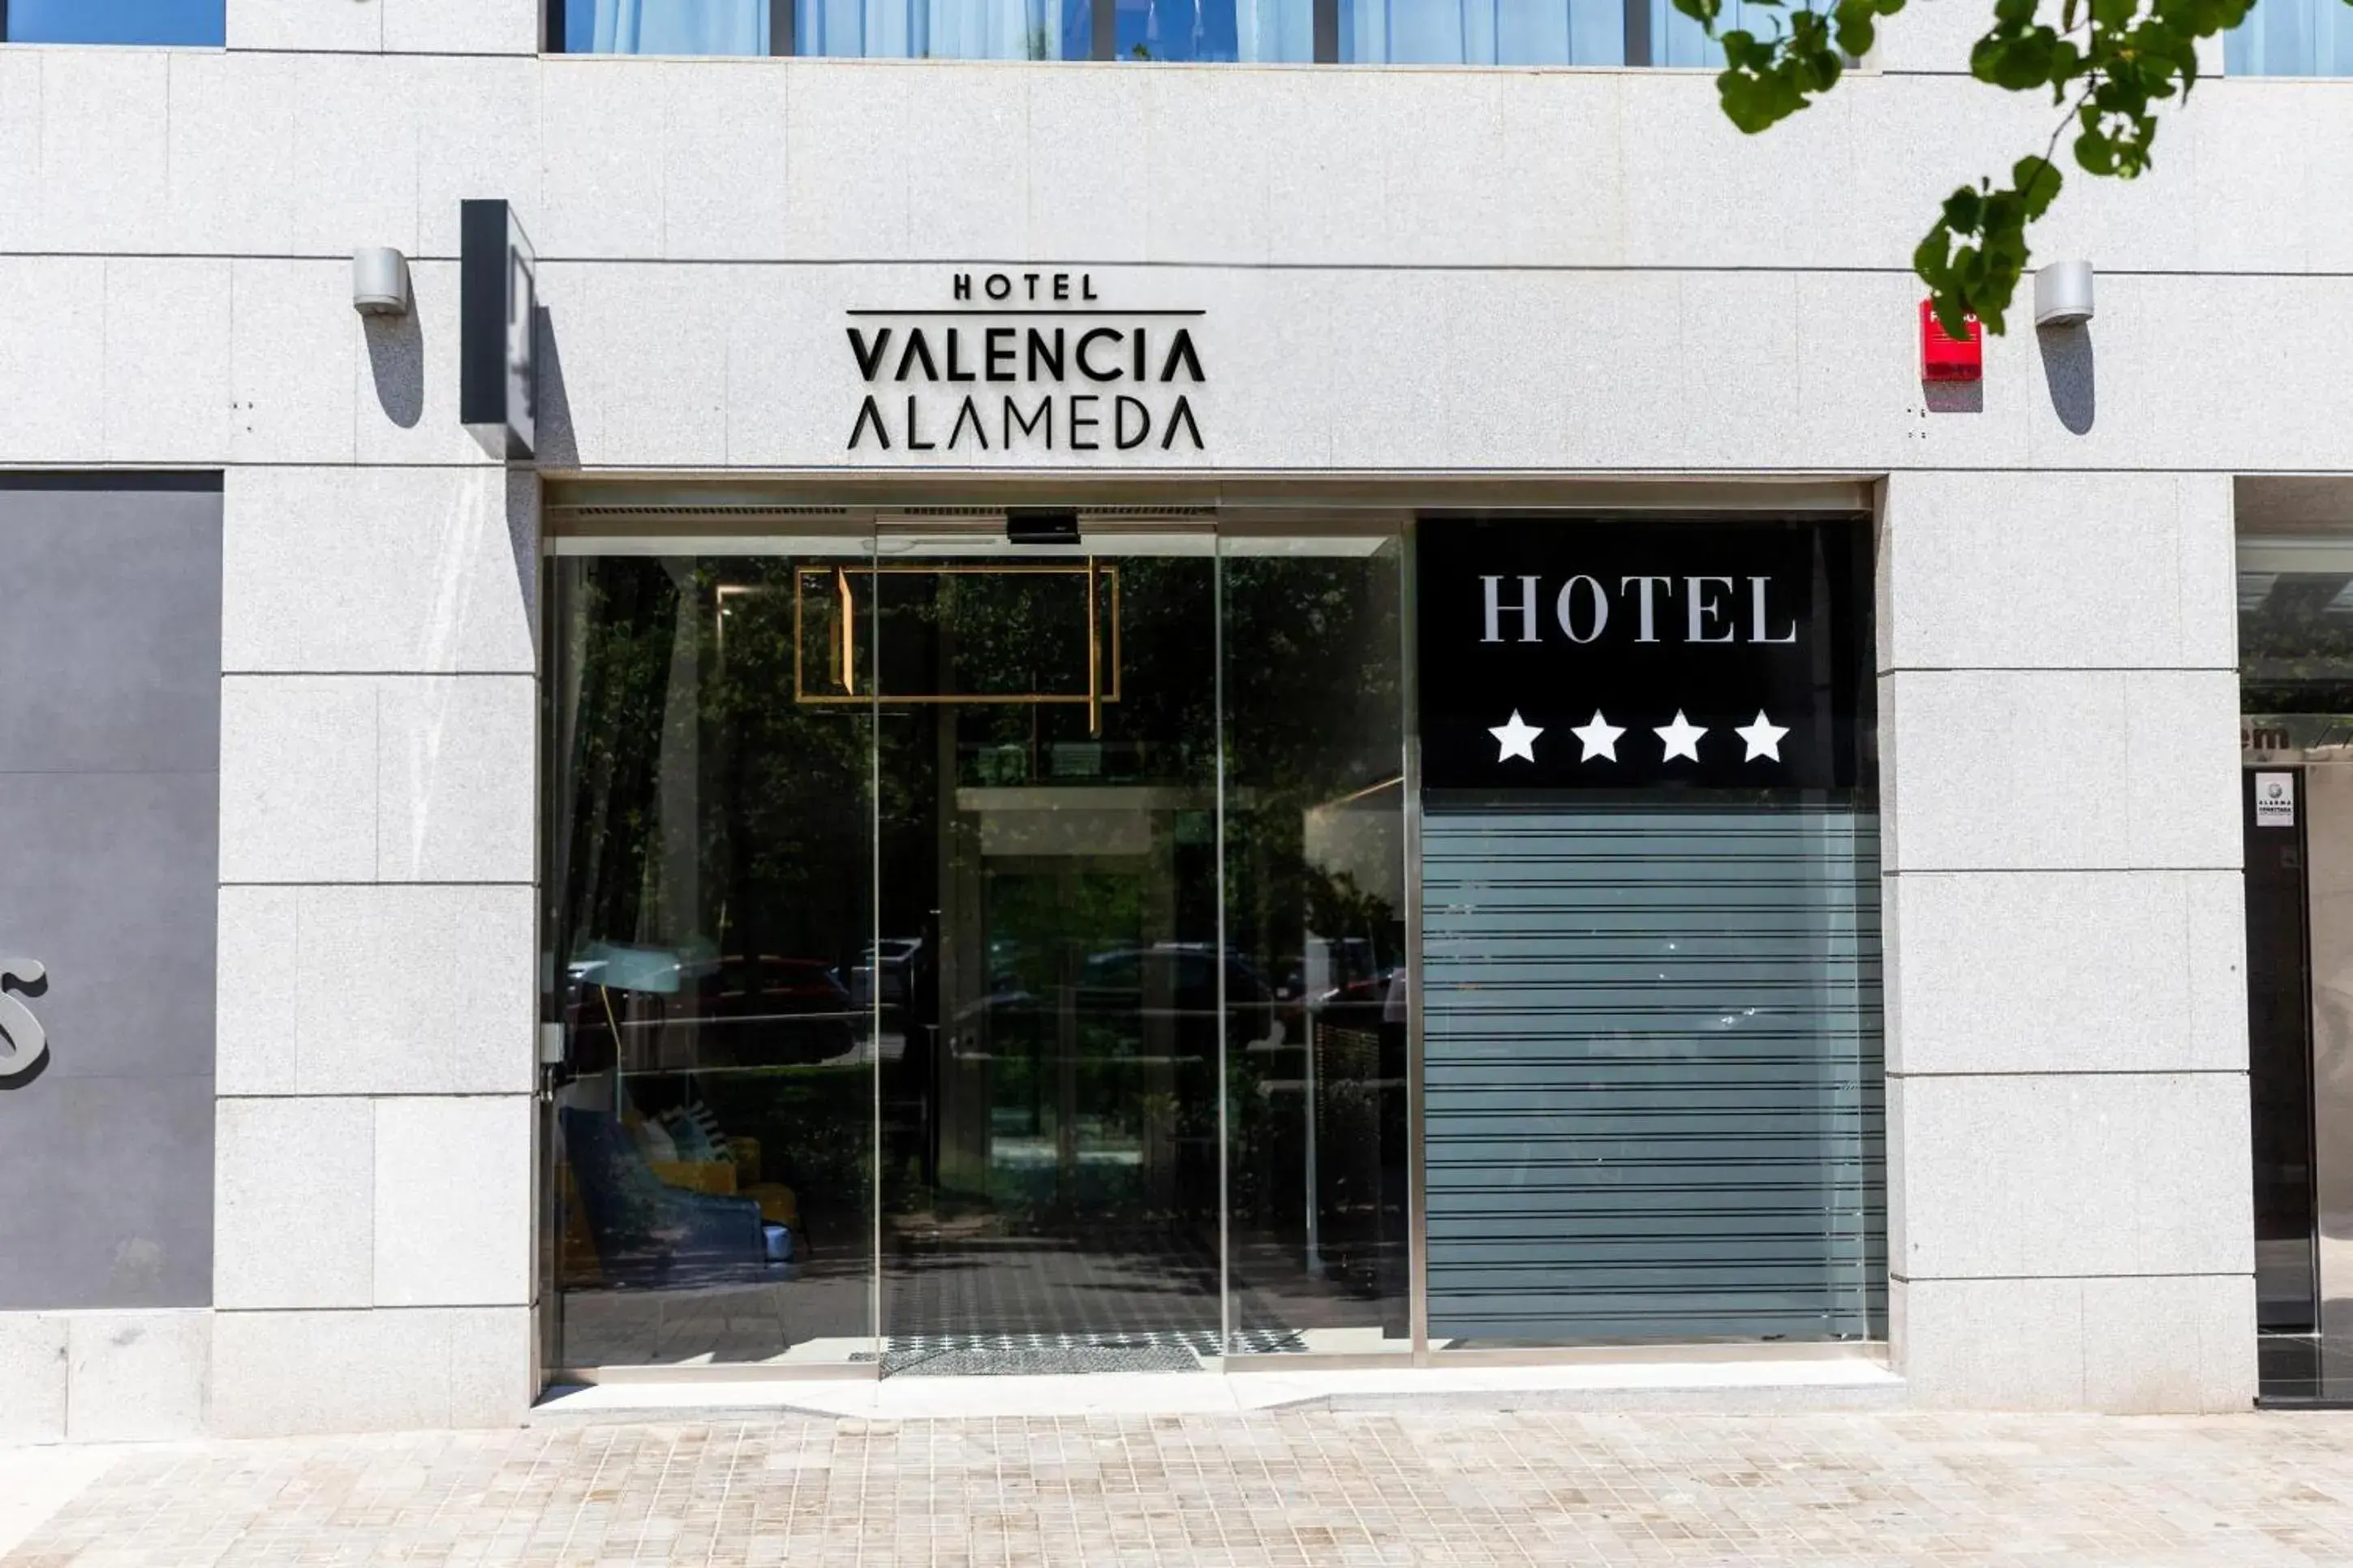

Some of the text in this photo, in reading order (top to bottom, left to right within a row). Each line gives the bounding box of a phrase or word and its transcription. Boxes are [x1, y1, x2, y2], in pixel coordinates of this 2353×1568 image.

[953, 273, 1099, 301] HOTEL
[846, 327, 1207, 383] VALENCIA
[846, 394, 1206, 450] ALAMEDA
[1478, 574, 1796, 643] HOTEL
